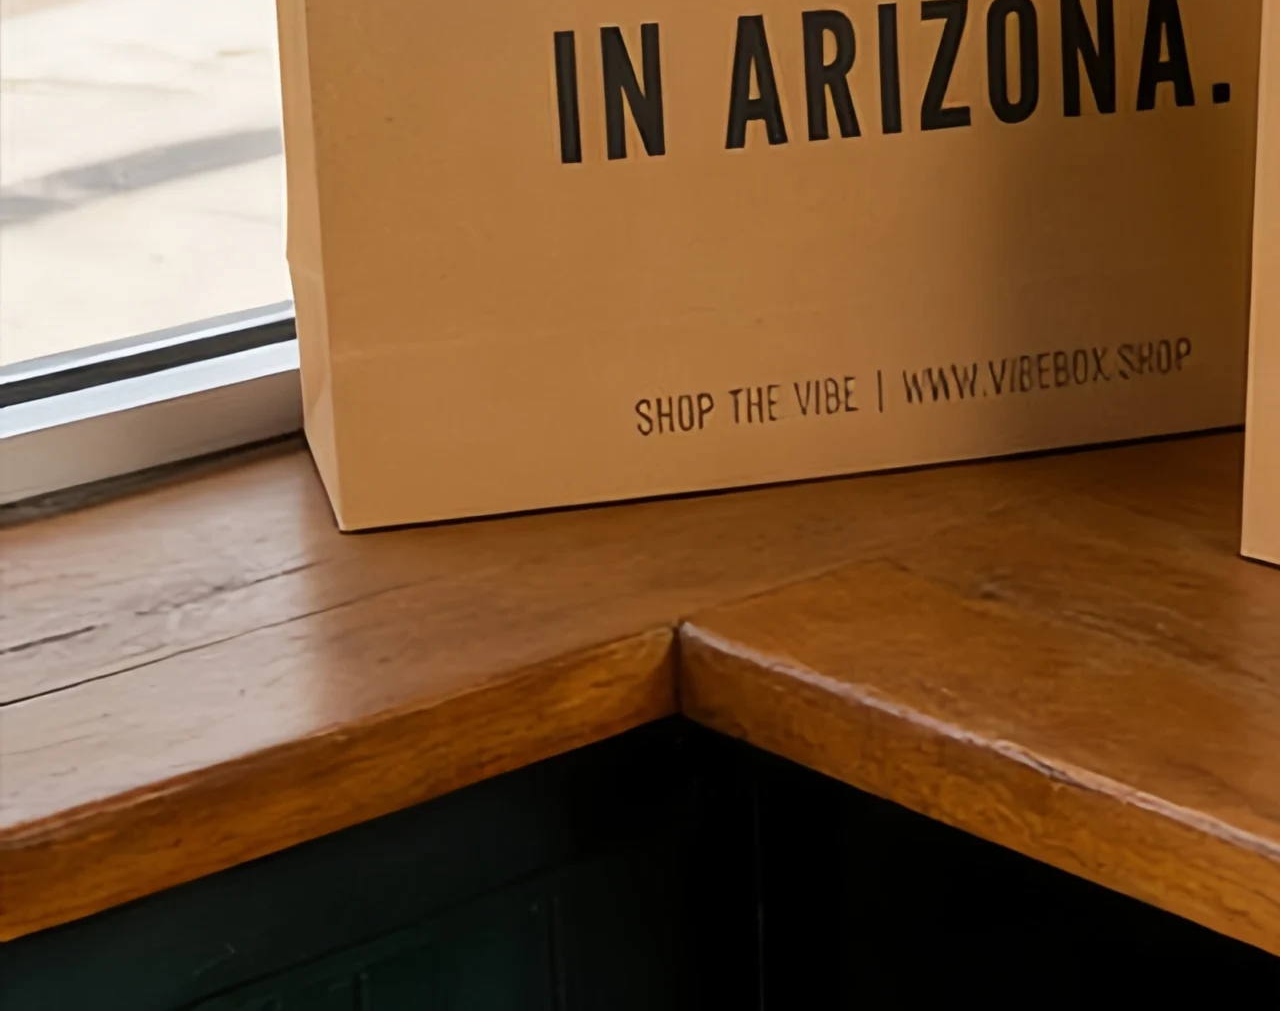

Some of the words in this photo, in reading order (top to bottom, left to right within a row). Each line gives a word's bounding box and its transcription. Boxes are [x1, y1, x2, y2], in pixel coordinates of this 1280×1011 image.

[553, 23, 666, 165] IN
[634, 392, 715, 436] SHOP
[728, 384, 782, 424] THE
[793, 376, 860, 416] VIBE
